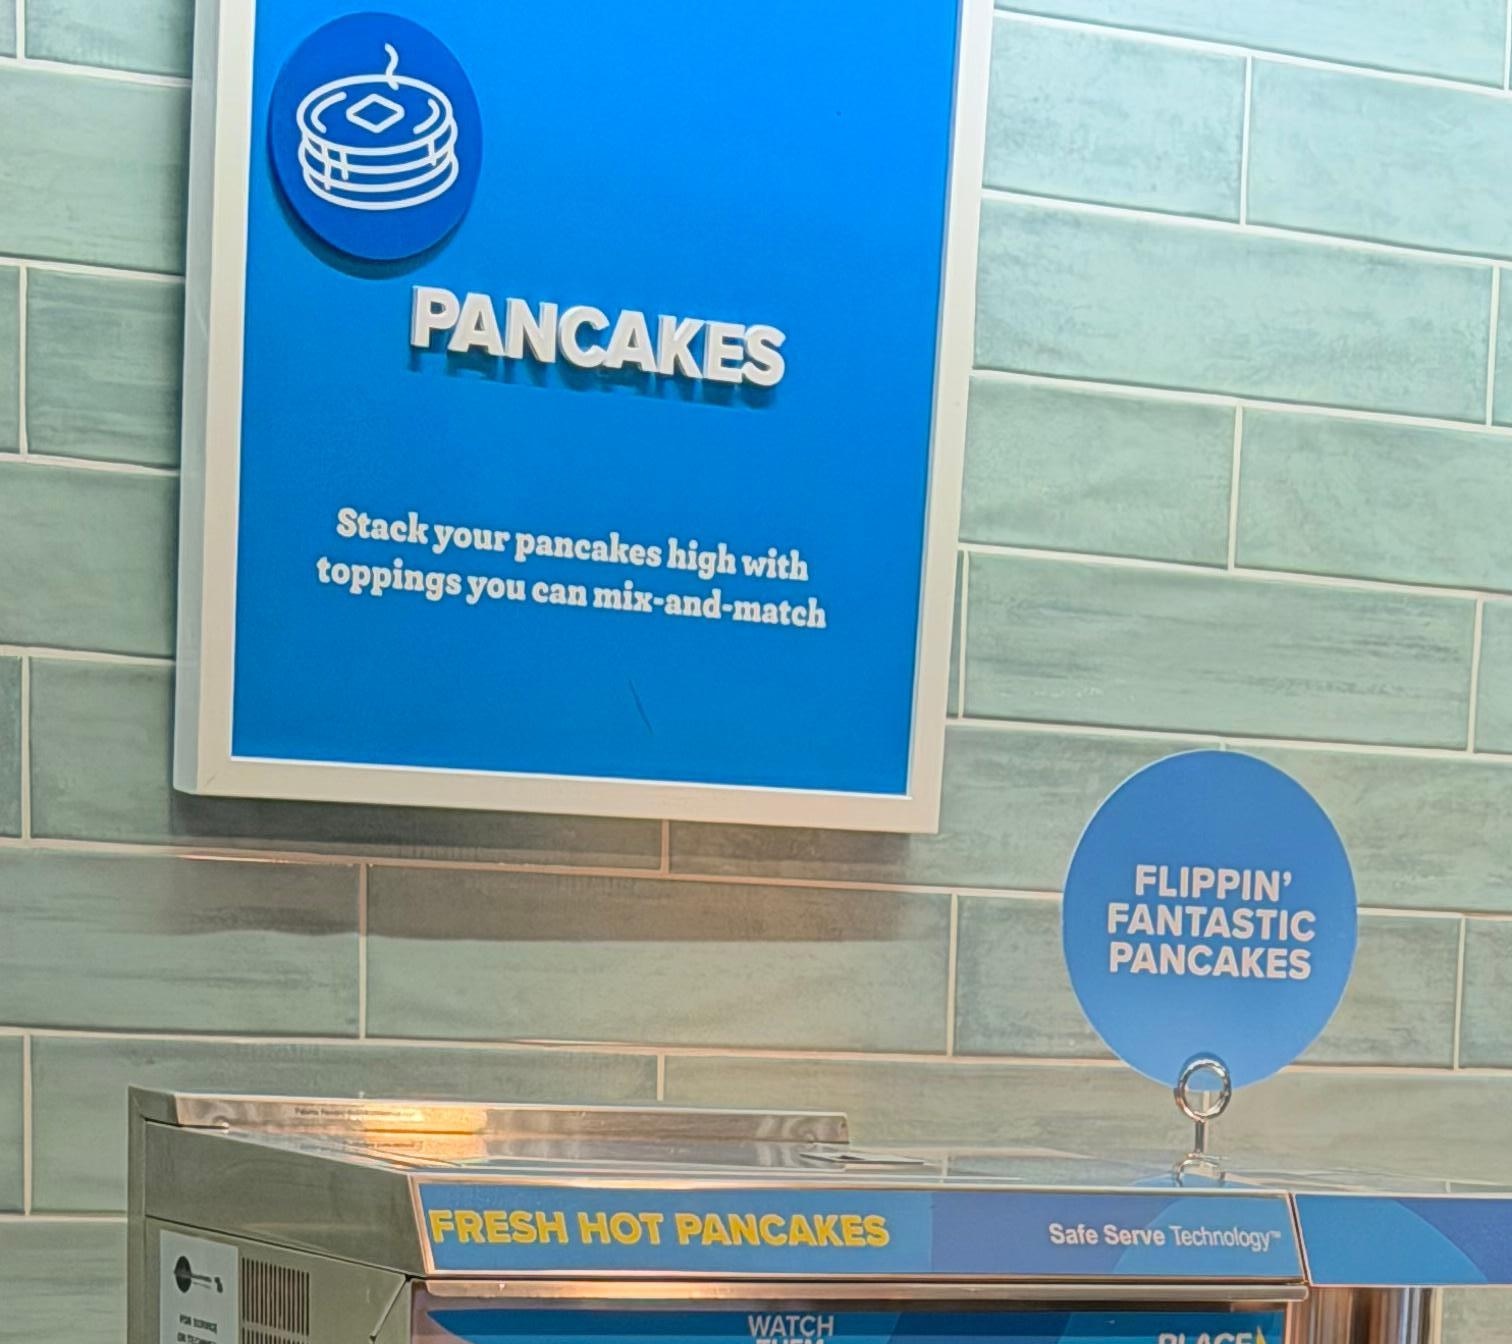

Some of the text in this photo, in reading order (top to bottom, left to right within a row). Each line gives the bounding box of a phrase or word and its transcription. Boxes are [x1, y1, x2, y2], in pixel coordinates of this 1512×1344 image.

[411, 285, 786, 387] PANCAKES
[336, 507, 809, 581] Stack your pancakes high with
[316, 556, 827, 629] toppings you can mix-and-match
[1107, 902, 1317, 943] FANTASTIC
[1109, 940, 1312, 981] PANCAKES
[428, 1209, 891, 1248] FRESH HOT PANCAKES
[1048, 1222, 1099, 1245] Safe
[1103, 1223, 1166, 1246] Serve
[747, 1314, 835, 1337] WATCH
